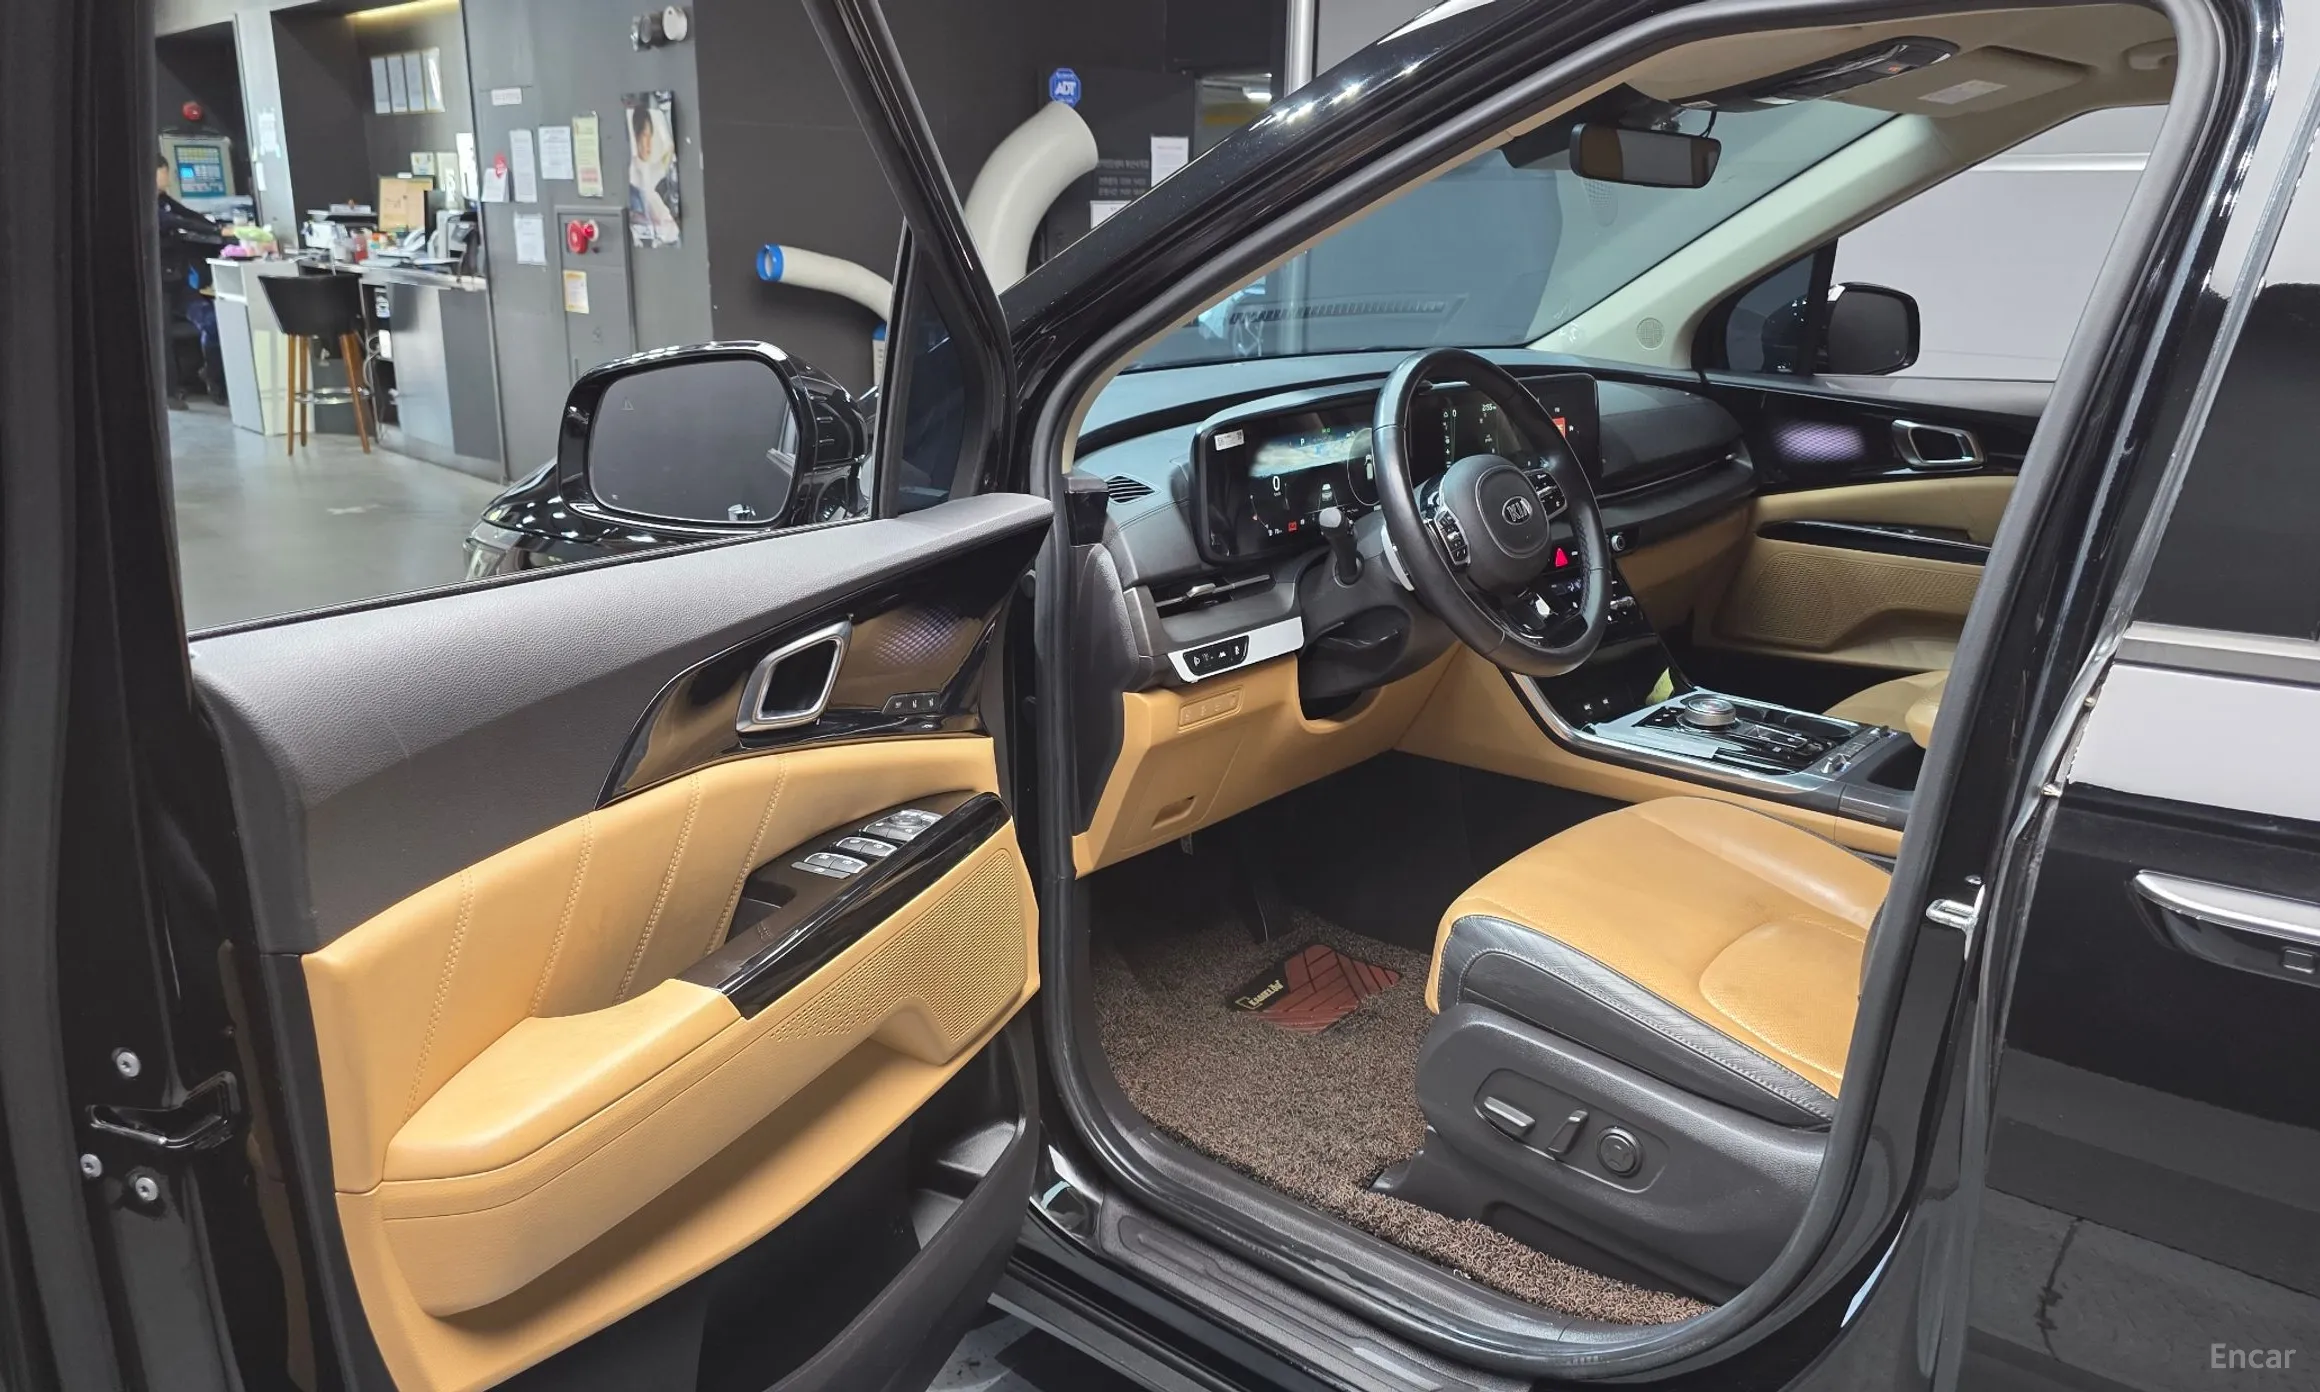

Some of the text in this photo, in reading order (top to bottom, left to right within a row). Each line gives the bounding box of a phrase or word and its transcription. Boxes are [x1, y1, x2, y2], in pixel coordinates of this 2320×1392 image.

[1054, 81, 1077, 96] ADT
[1272, 475, 1281, 492] 0
[1506, 501, 1528, 522] KIA
